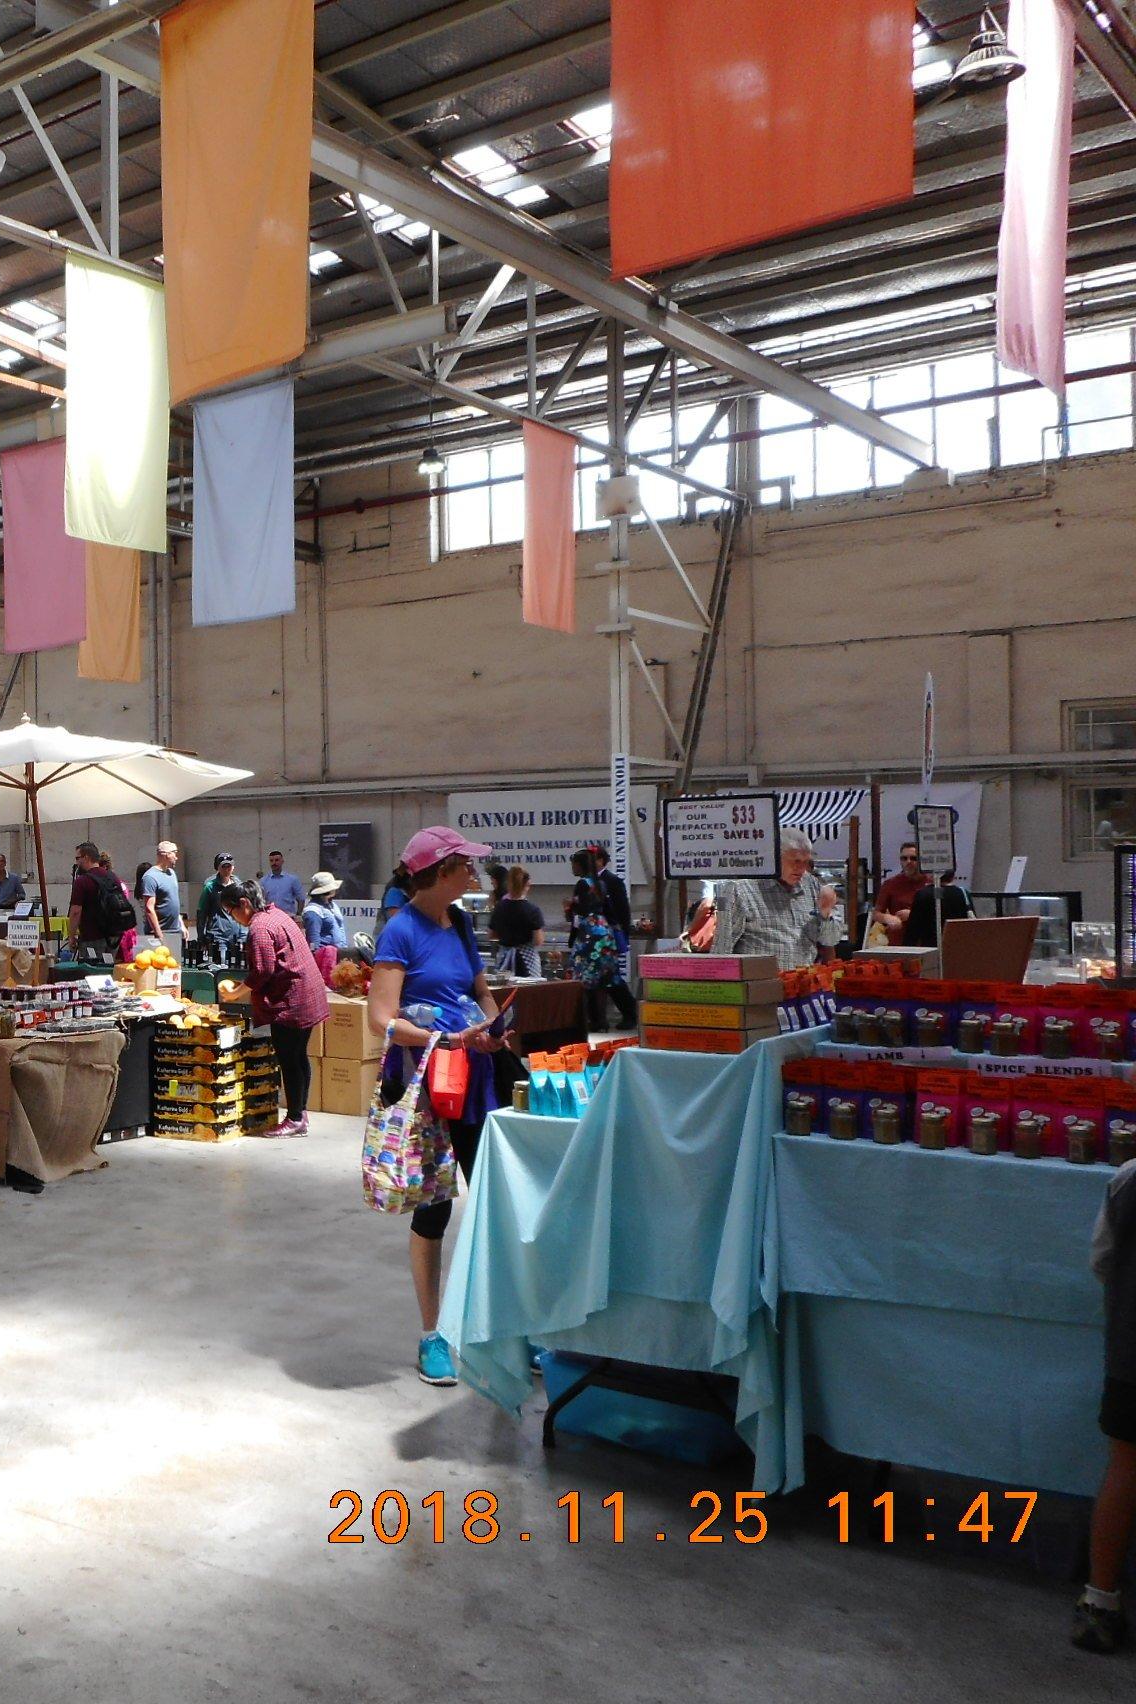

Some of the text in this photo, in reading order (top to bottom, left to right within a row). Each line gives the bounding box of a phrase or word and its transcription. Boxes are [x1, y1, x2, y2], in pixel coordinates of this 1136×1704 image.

[615, 757, 626, 814] CANNOLI
[458, 807, 647, 828] CANNOLI BROTHS
[732, 804, 755, 826] $33
[669, 823, 727, 831] PREPACKED
[723, 830, 750, 840] SAVE
[516, 840, 572, 850] HANDMADE
[575, 839, 612, 849] CANNO
[525, 854, 553, 864] MADE
[556, 854, 567, 863] IN
[867, 1052, 904, 1061] LAMB
[985, 1064, 1094, 1076] SPICE BLENDS
